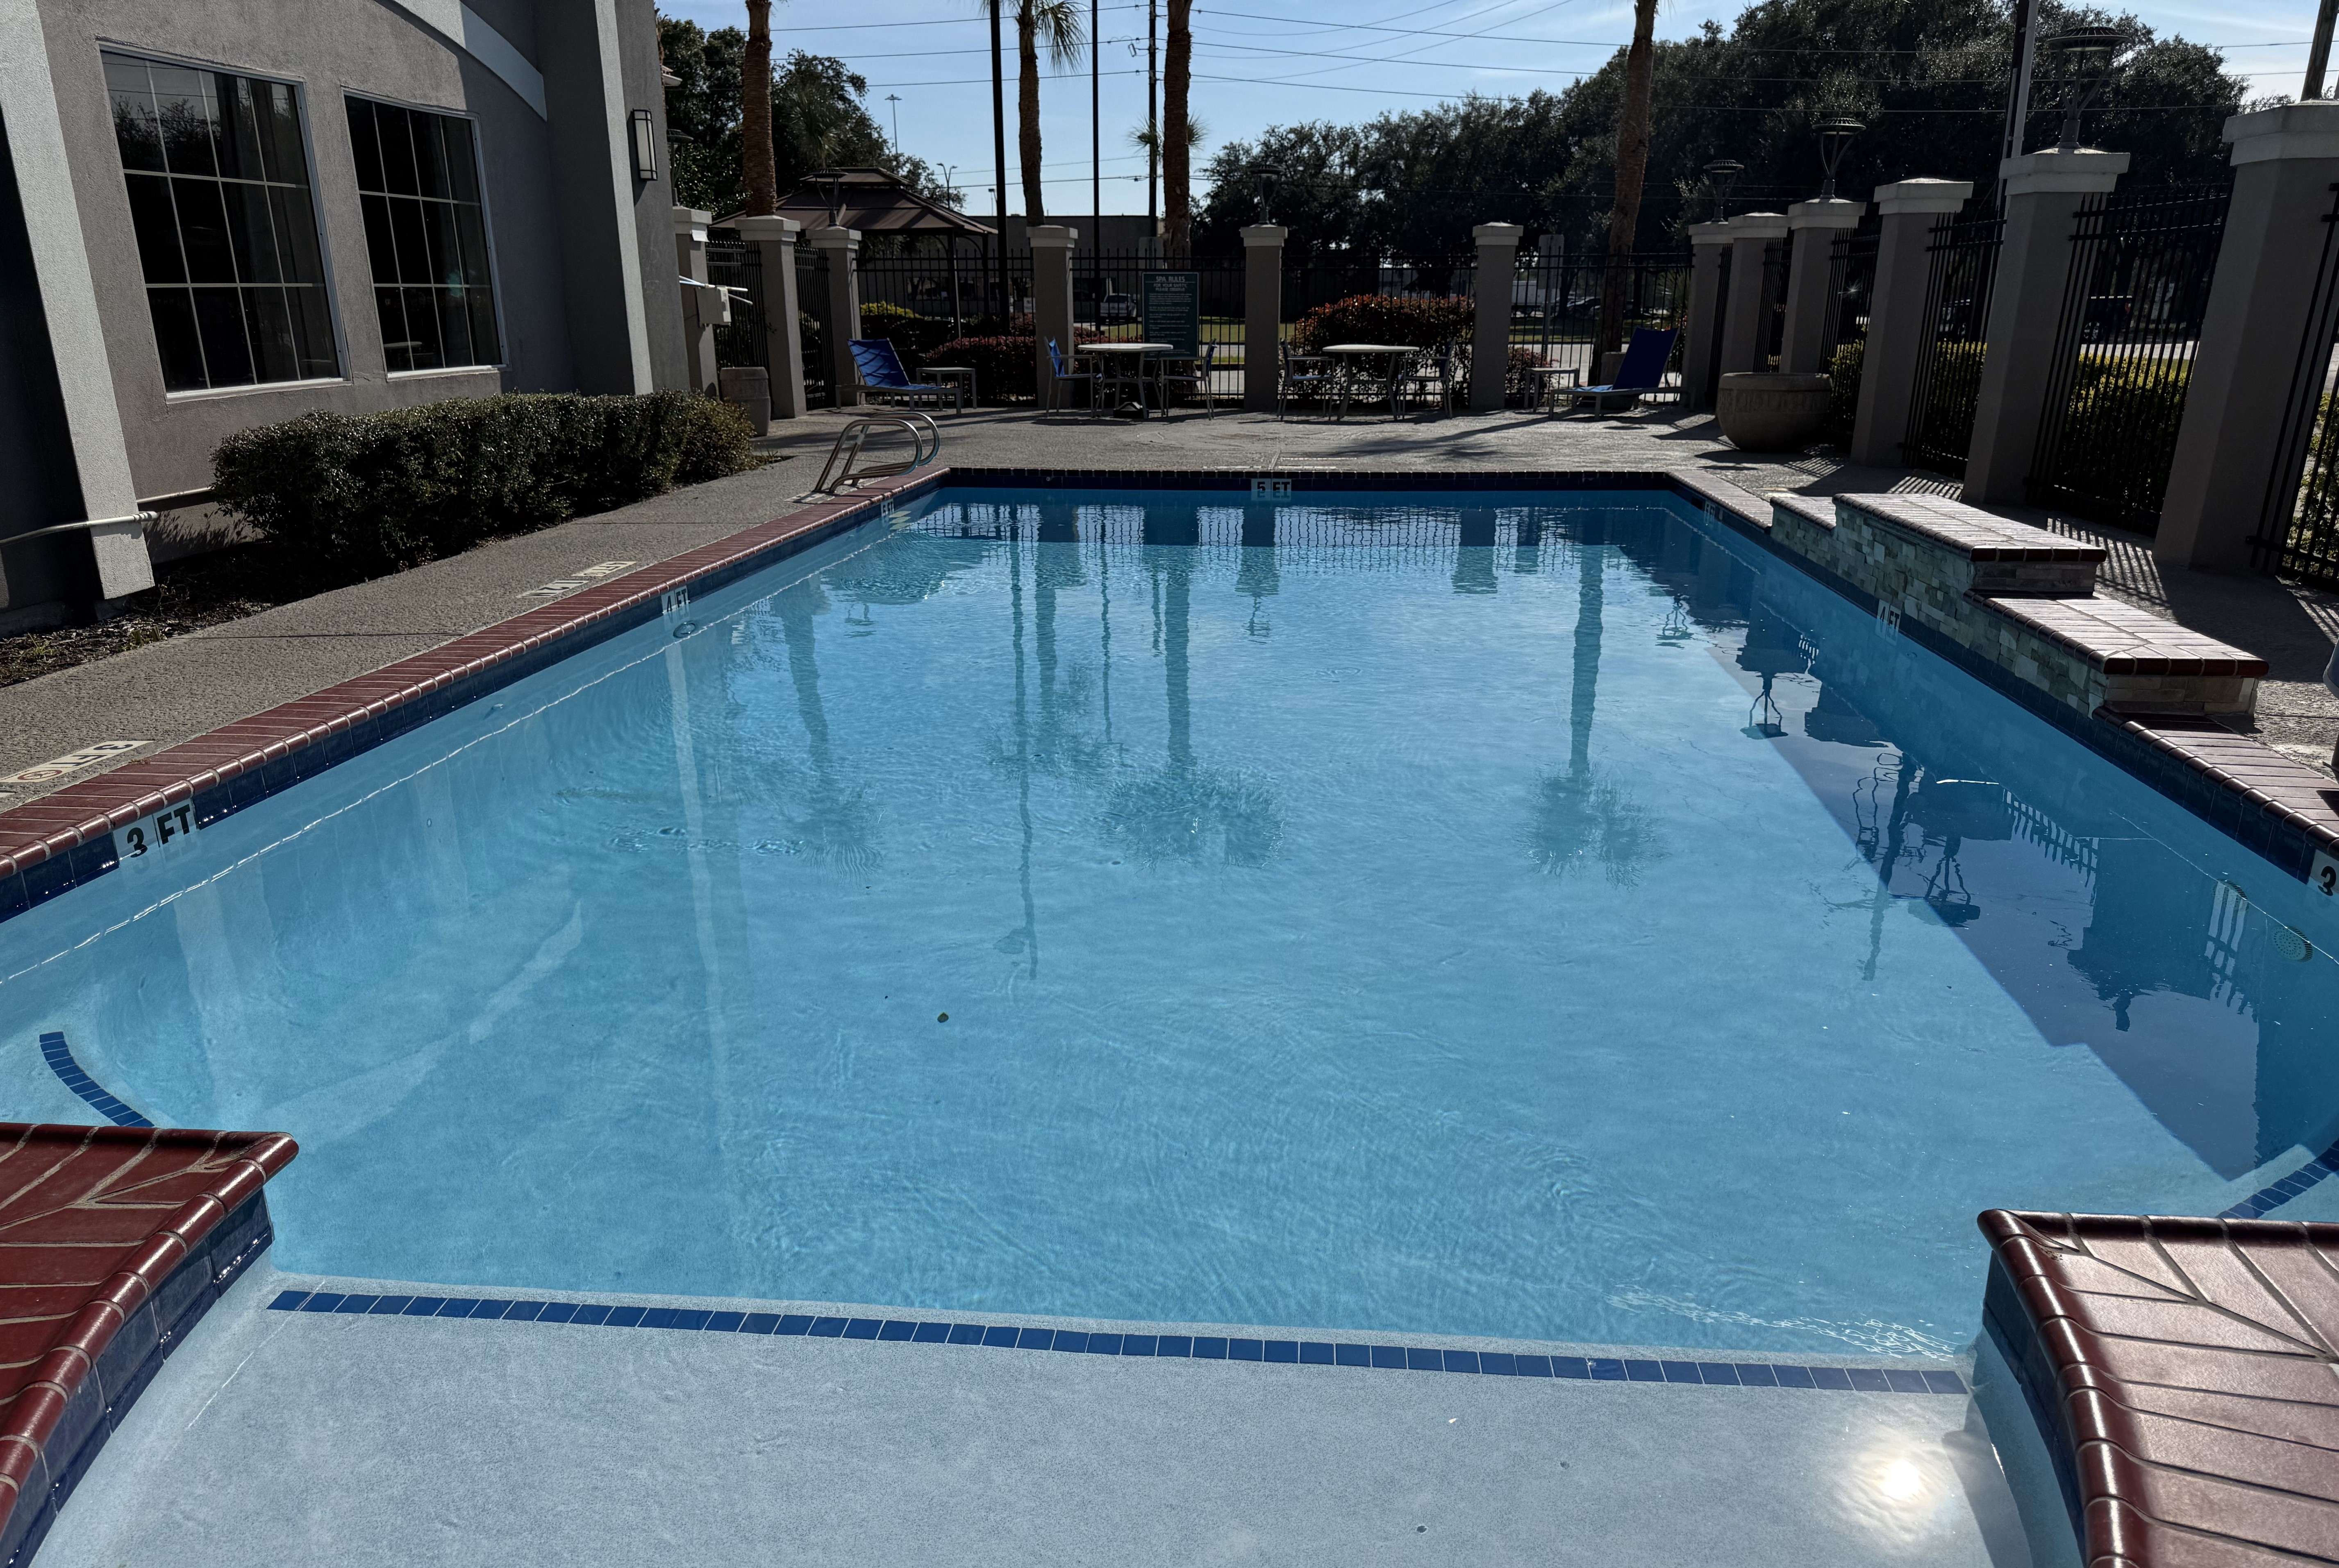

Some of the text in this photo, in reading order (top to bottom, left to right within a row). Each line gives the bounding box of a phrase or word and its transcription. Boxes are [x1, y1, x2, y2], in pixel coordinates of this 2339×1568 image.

[676, 589, 687, 608] FT
[1888, 610, 1900, 629] FT
[50, 754, 108, 766] FT
[127, 804, 191, 858] 3 FT
[2318, 866, 2337, 896] 3
